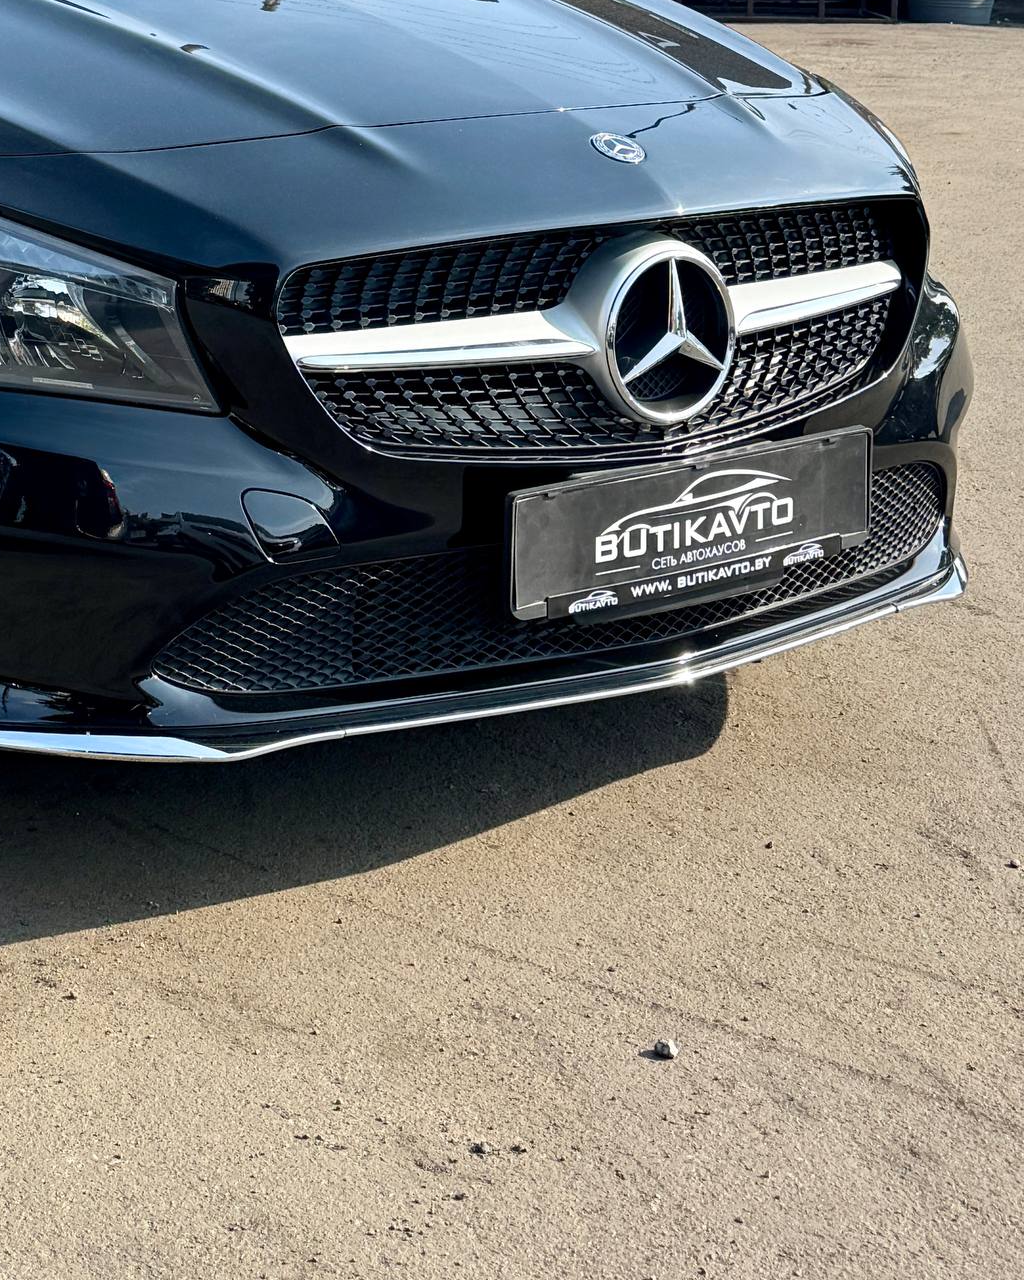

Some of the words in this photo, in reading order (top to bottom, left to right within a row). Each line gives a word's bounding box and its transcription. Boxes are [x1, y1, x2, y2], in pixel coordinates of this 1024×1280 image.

[595, 497, 794, 564] BUTIKAVTO
[651, 554, 677, 570] СЕТЬ
[679, 539, 746, 565] АВТОХАУСОВ
[677, 556, 772, 589] BUTIKAVTO.BY
